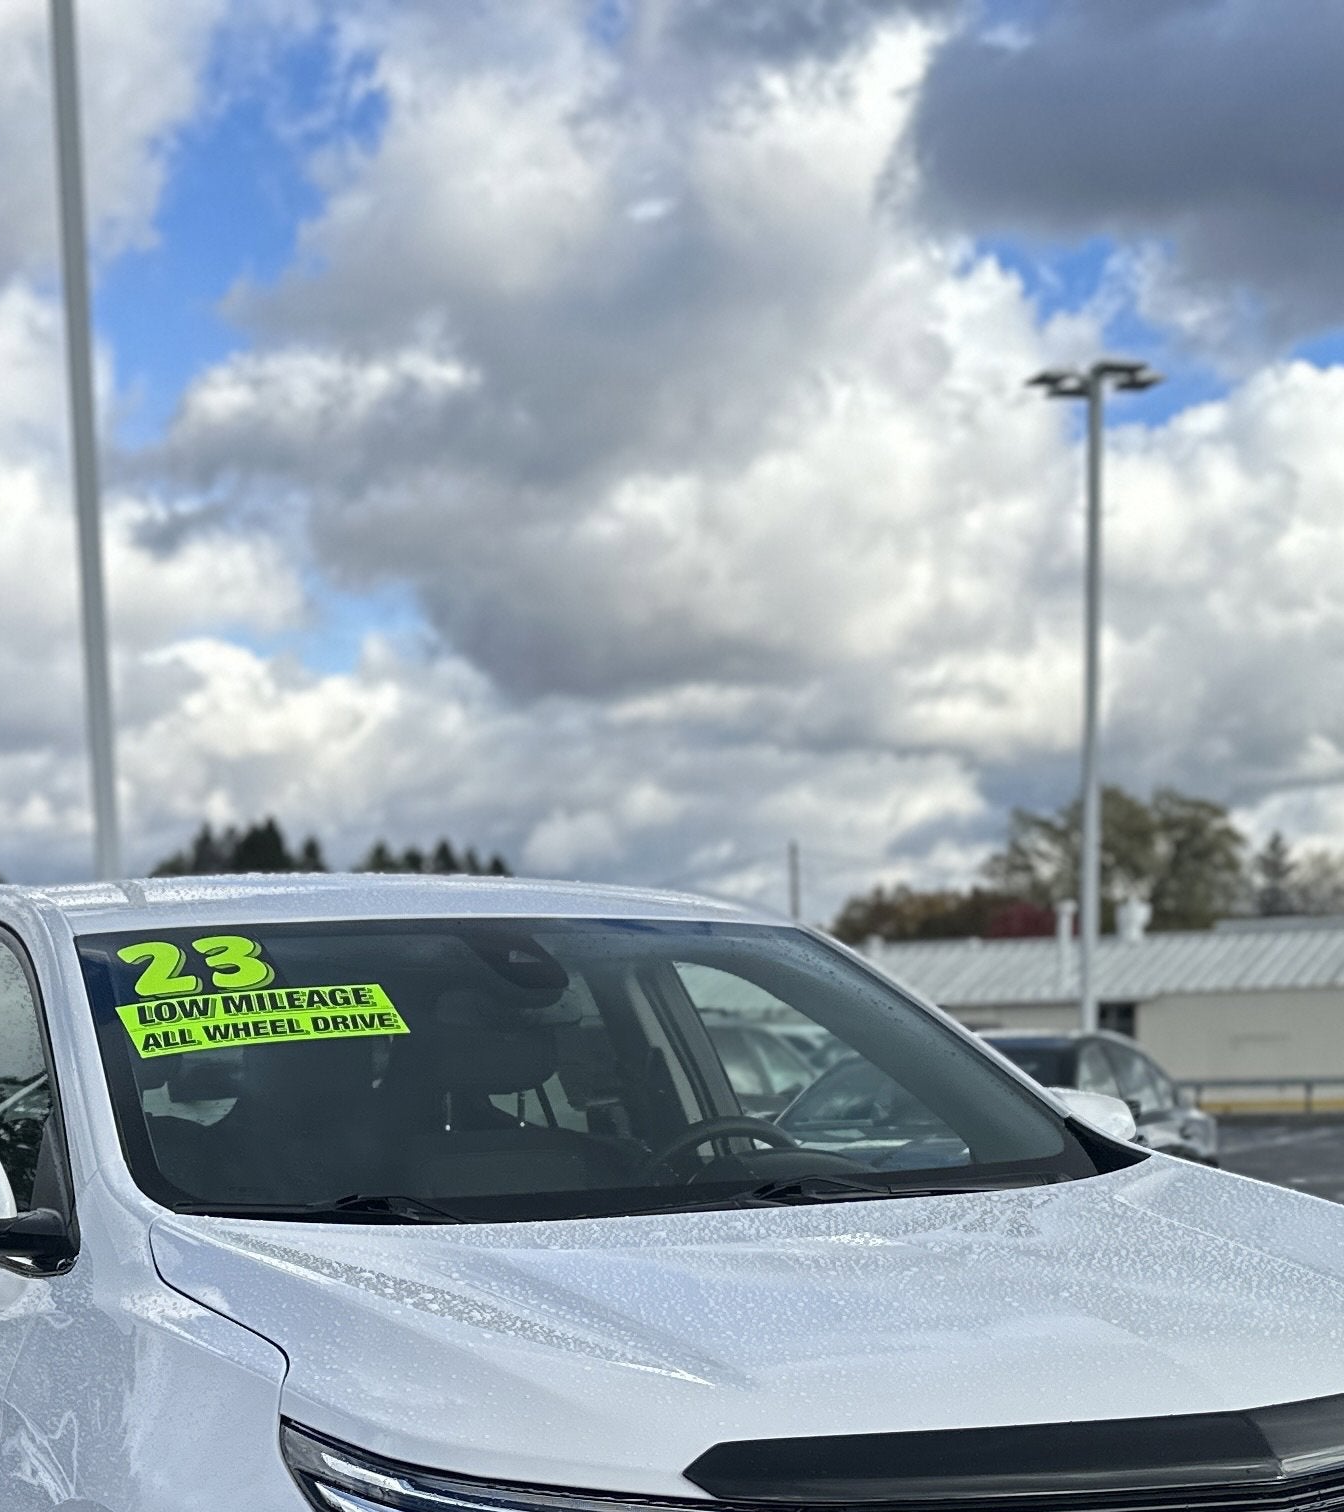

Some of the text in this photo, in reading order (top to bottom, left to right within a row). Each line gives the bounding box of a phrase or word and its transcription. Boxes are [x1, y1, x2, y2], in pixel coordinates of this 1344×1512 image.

[116, 935, 275, 998] 23
[137, 987, 376, 1027] LOW MILEAGE
[141, 1012, 401, 1052] ALL WHEEL DRIVE
